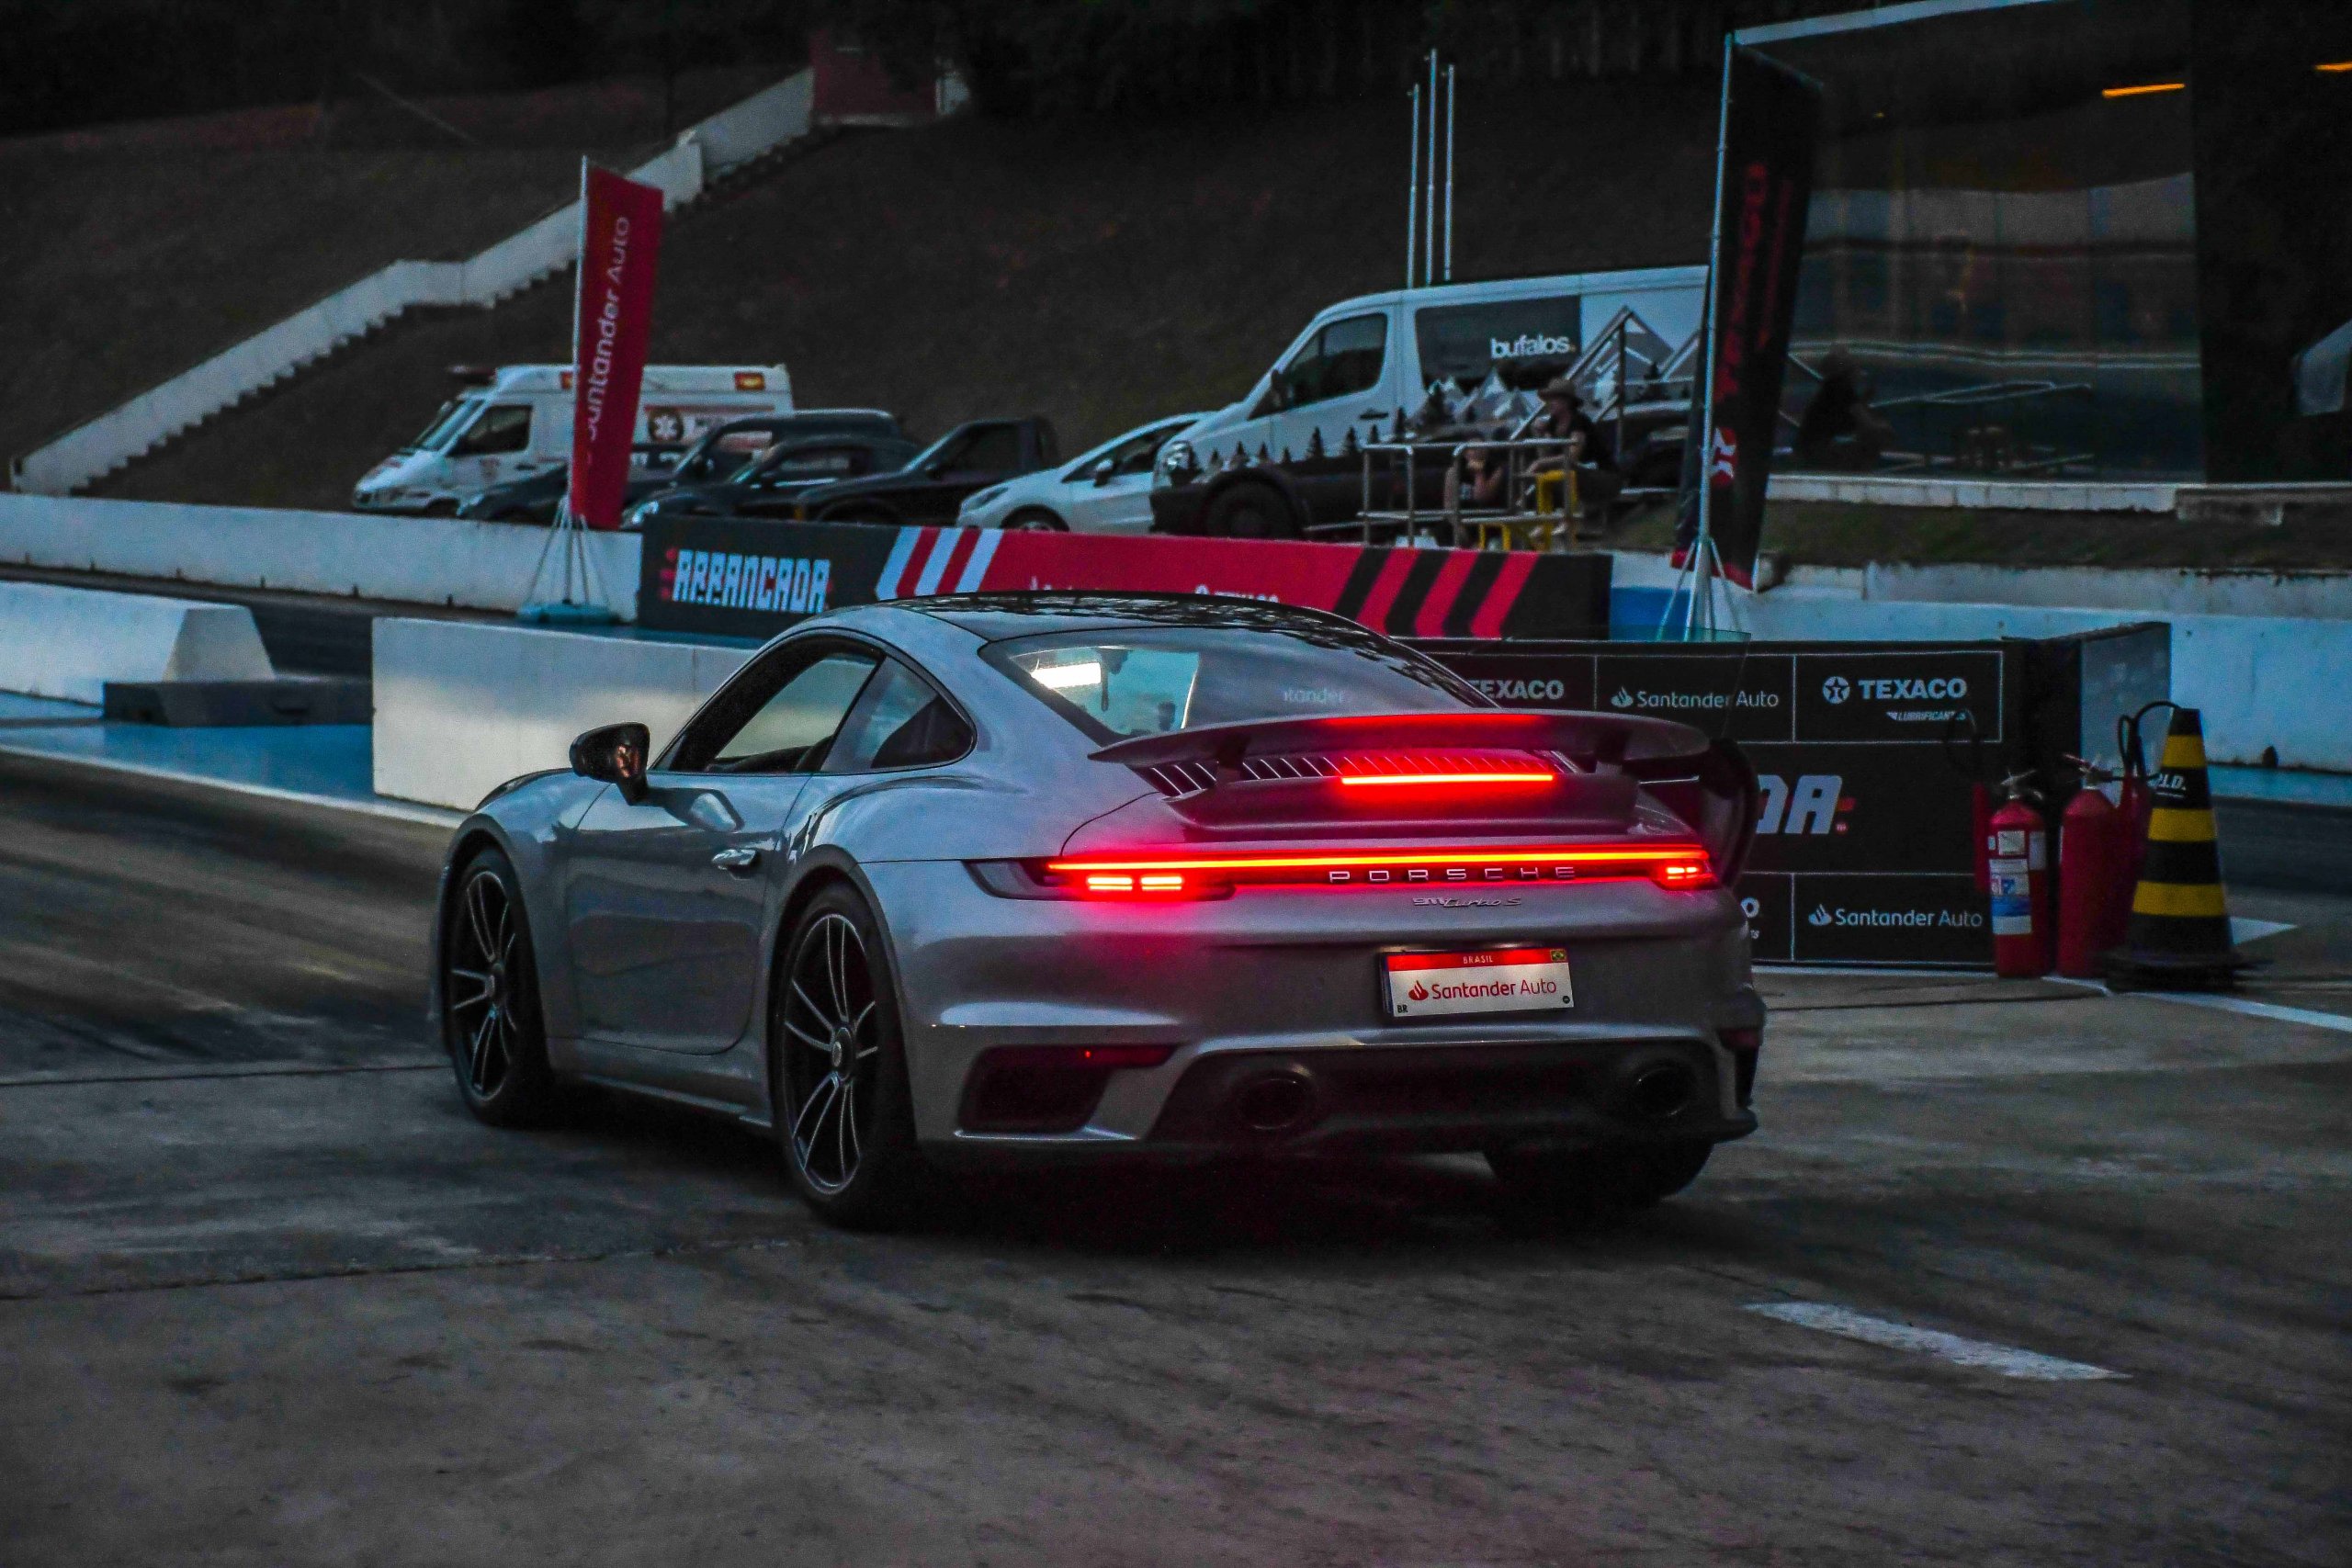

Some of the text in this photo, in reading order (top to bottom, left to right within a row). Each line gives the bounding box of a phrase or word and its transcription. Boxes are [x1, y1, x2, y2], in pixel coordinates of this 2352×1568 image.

[673, 549, 831, 614] ARRANCADA
[1858, 678, 1967, 700] TEXACO
[1636, 691, 1779, 709] Santander Auto
[1329, 866, 1575, 883] PORSCHE
[1835, 908, 1984, 928] Santander Auto
[1463, 955, 1493, 964] BRASIL
[1431, 978, 1557, 1000] Santander Auto
[1397, 1004, 1408, 1014] BR
